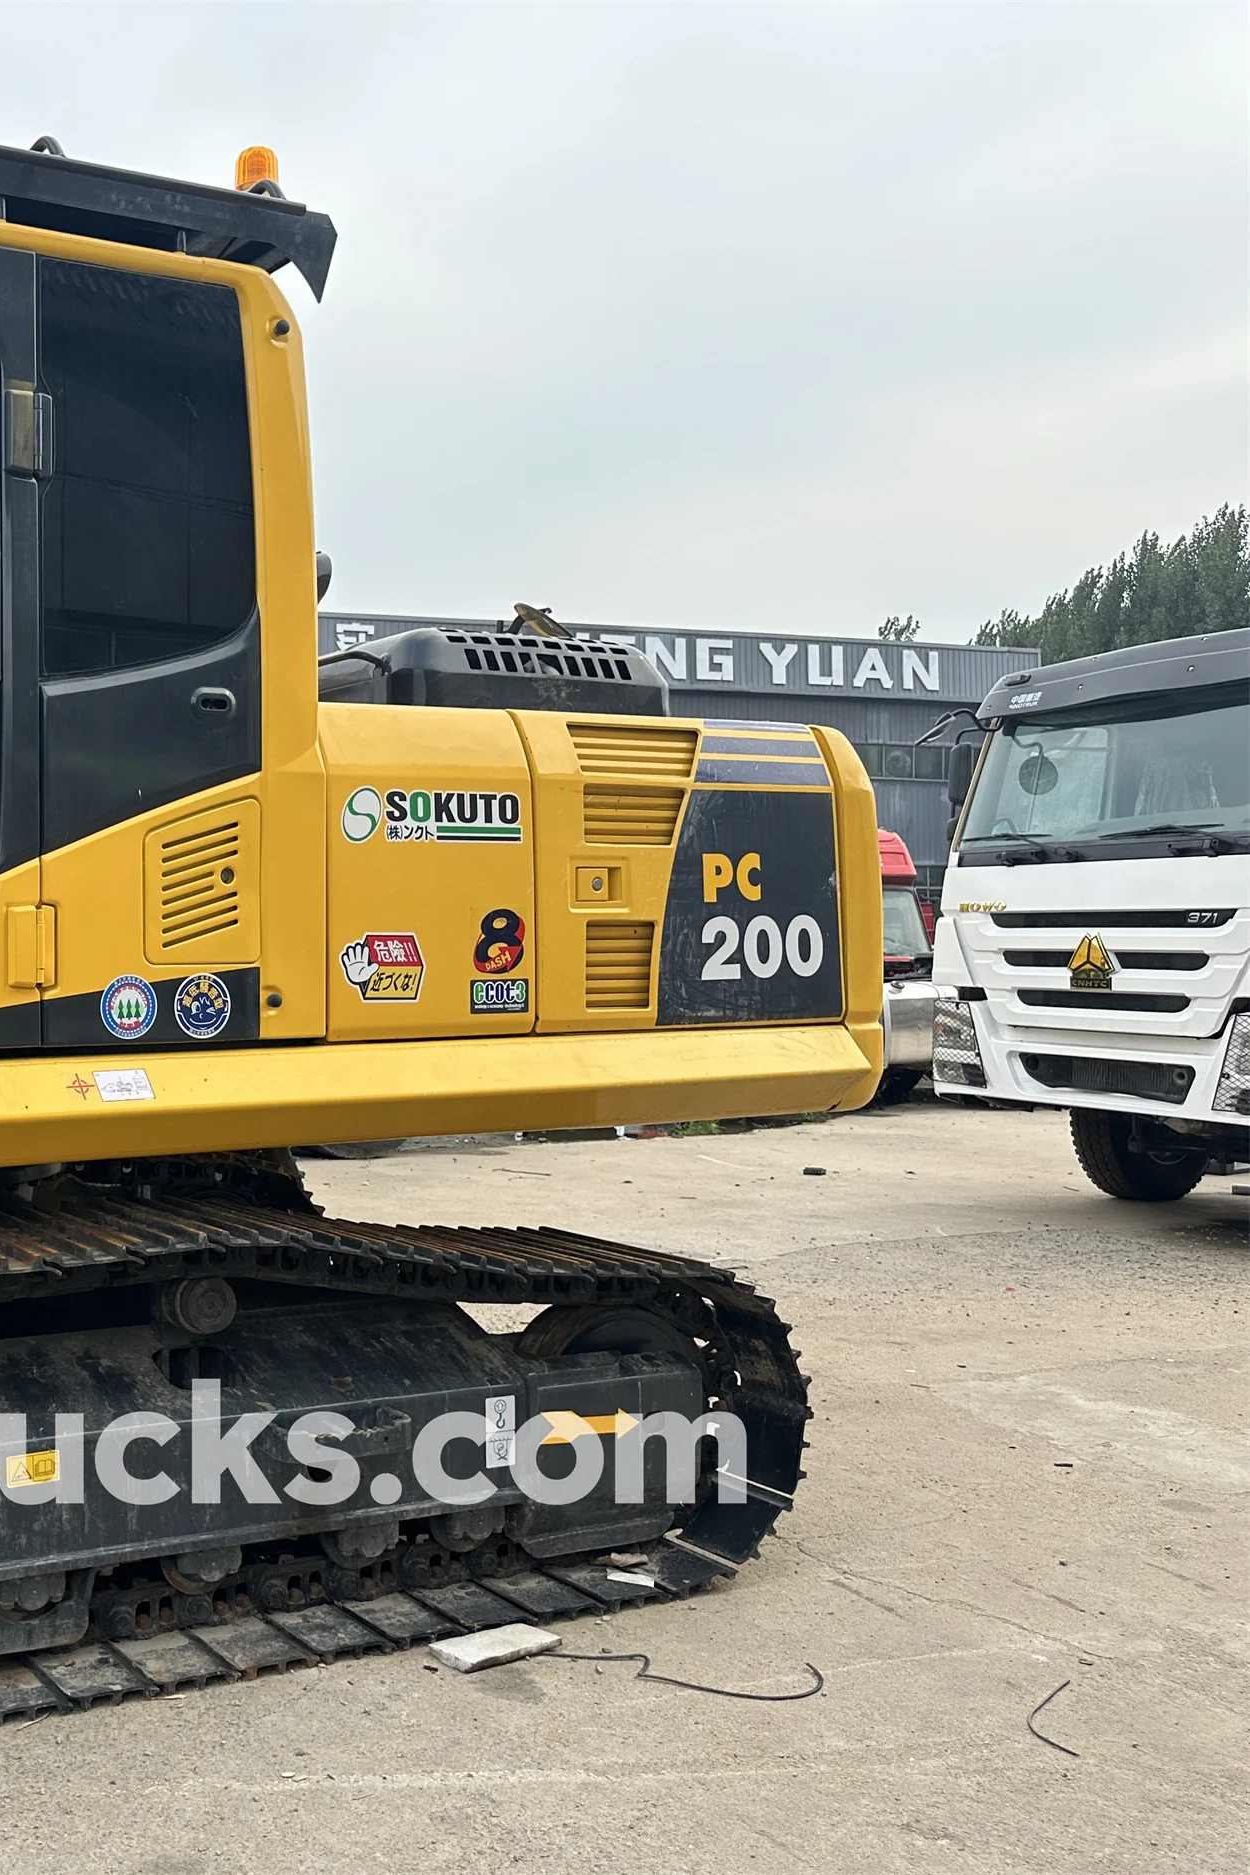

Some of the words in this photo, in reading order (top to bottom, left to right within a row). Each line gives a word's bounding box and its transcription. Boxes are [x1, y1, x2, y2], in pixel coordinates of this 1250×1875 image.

[759, 642, 940, 691] YUAN
[385, 790, 520, 825] SOKUTO
[702, 852, 762, 903] PC
[1187, 912, 1218, 924] 371
[485, 950, 512, 971] DASH
[701, 914, 824, 981] 200
[474, 980, 526, 1004] ecot3
[1070, 979, 1109, 989] CNHTC
